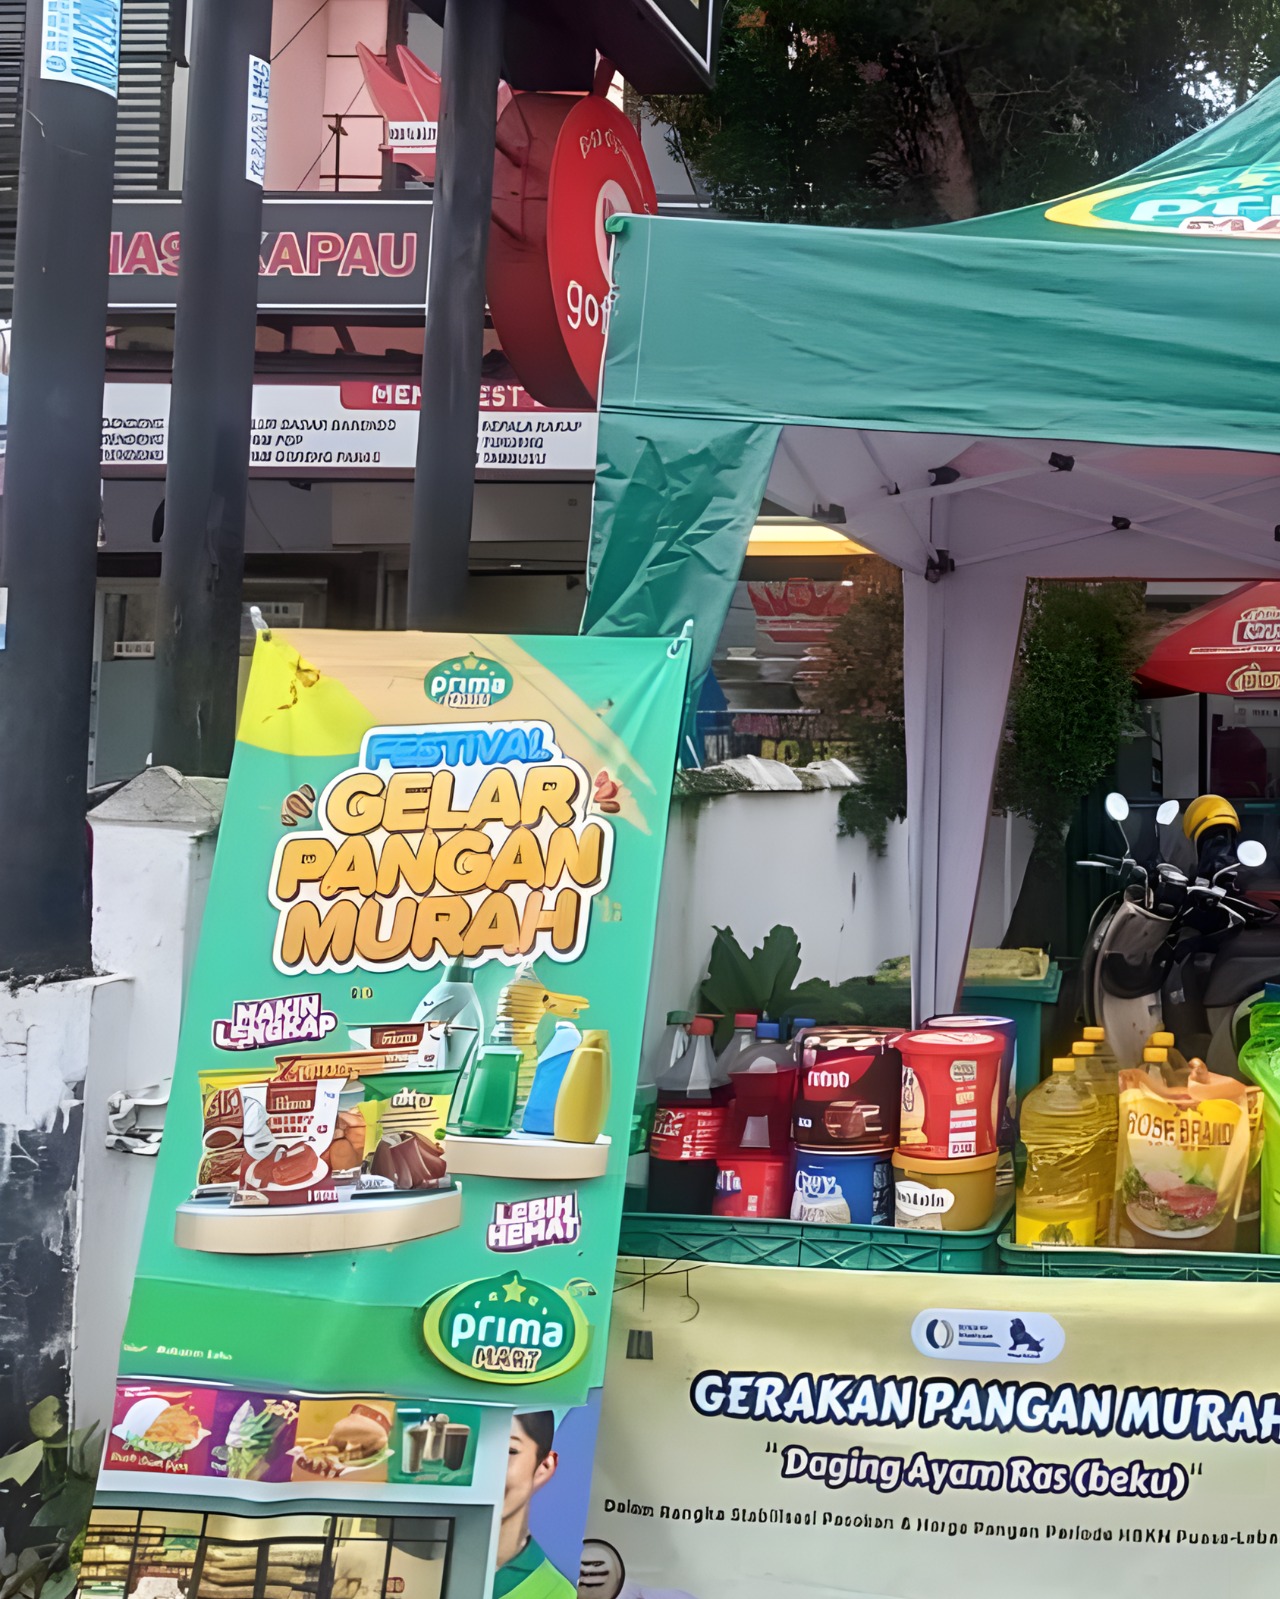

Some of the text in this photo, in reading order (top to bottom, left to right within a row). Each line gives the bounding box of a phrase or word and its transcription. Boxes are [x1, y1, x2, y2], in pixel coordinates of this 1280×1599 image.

[366, 727, 554, 770] FESTIVAL
[325, 764, 581, 835] GELAR
[276, 822, 605, 902] PANGAN
[281, 886, 582, 966] MURAH
[451, 1313, 563, 1348] prima
[691, 1370, 918, 1427] GERAKAN
[920, 1376, 1116, 1437] PANGAN
[904, 1452, 1005, 1494] Ayam
[1007, 1456, 1070, 1494] Ras
